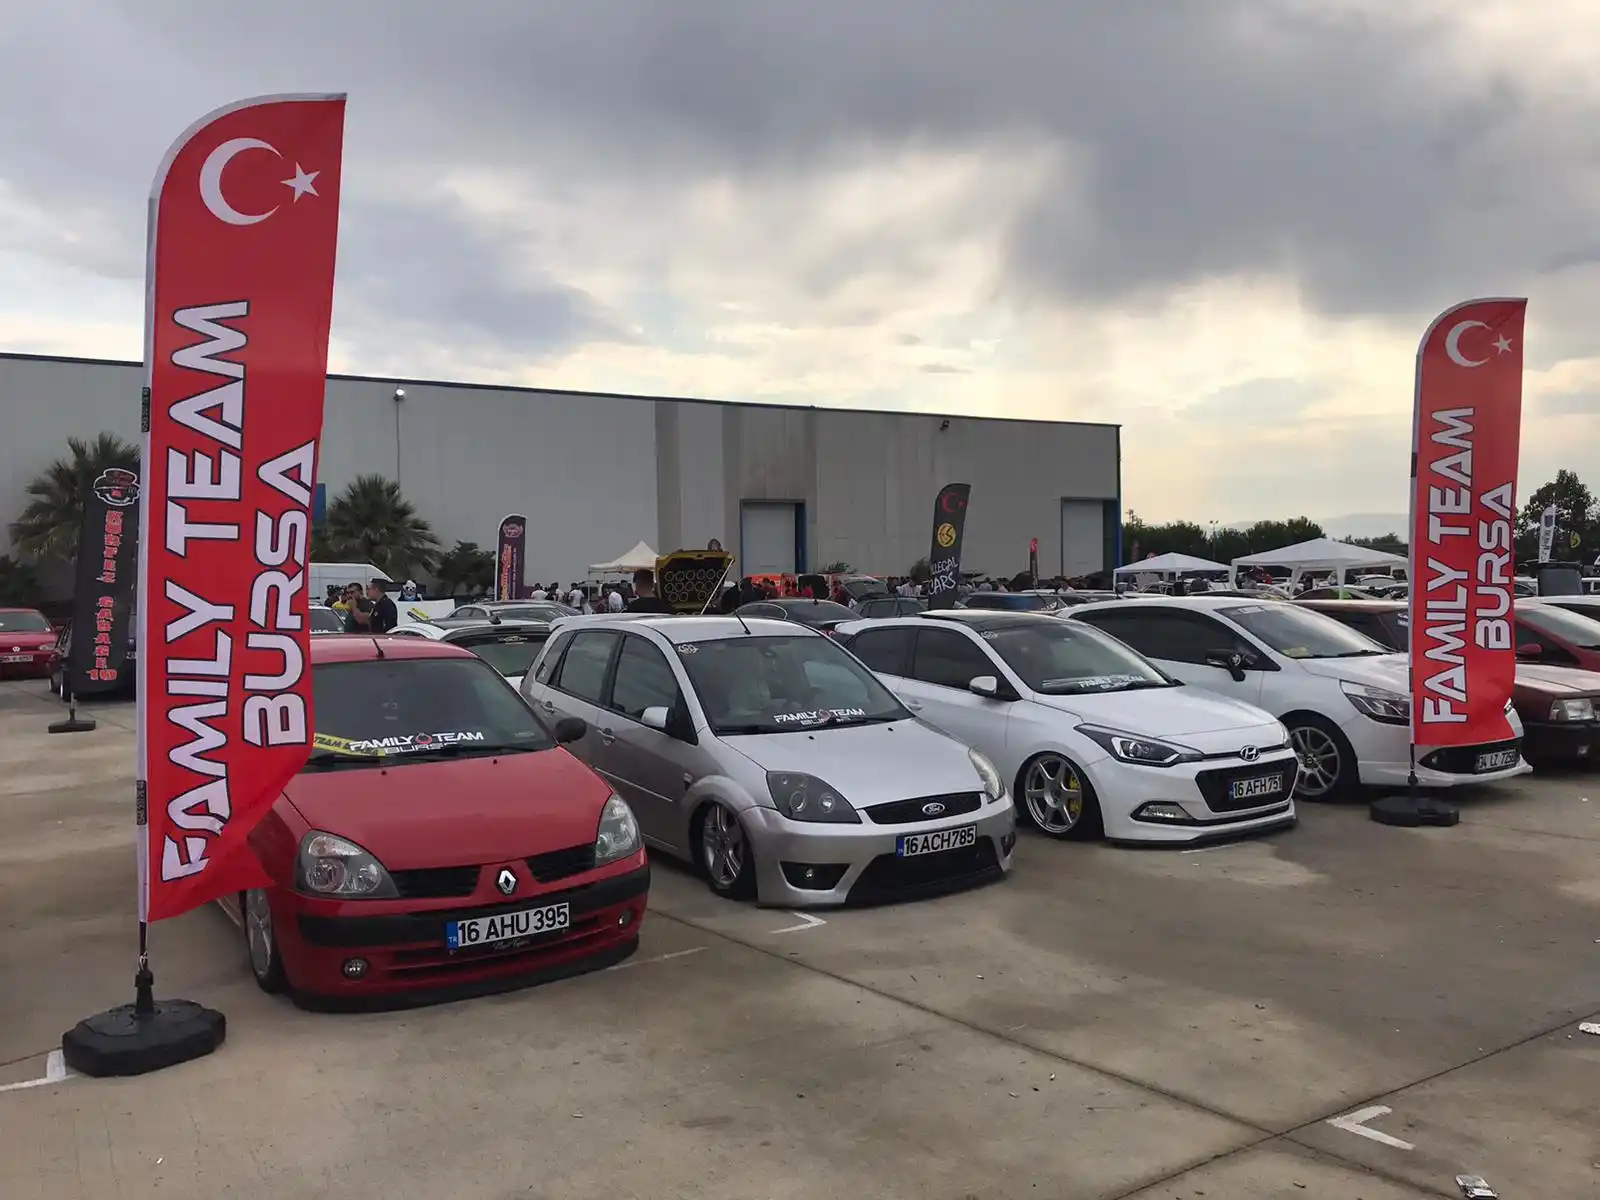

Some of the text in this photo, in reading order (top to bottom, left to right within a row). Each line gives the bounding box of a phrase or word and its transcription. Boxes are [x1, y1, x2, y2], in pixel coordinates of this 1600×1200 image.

[1422, 406, 1475, 724] FAMILY TEAM
[1475, 481, 1513, 650] BURSA
[161, 300, 249, 883] FAMILY TEAM
[243, 438, 316, 748] BURSA
[926, 572, 956, 595] CARS
[774, 708, 866, 723] FAMILY TEAM
[350, 735, 414, 751] FAMILY
[431, 731, 484, 743] TEAM
[1232, 781, 1244, 797] 16
[1246, 778, 1267, 795] AFH
[905, 827, 975, 855] 16 ACH 785
[458, 920, 480, 945] 16
[485, 911, 530, 940] AHU
[533, 904, 568, 931] 395
